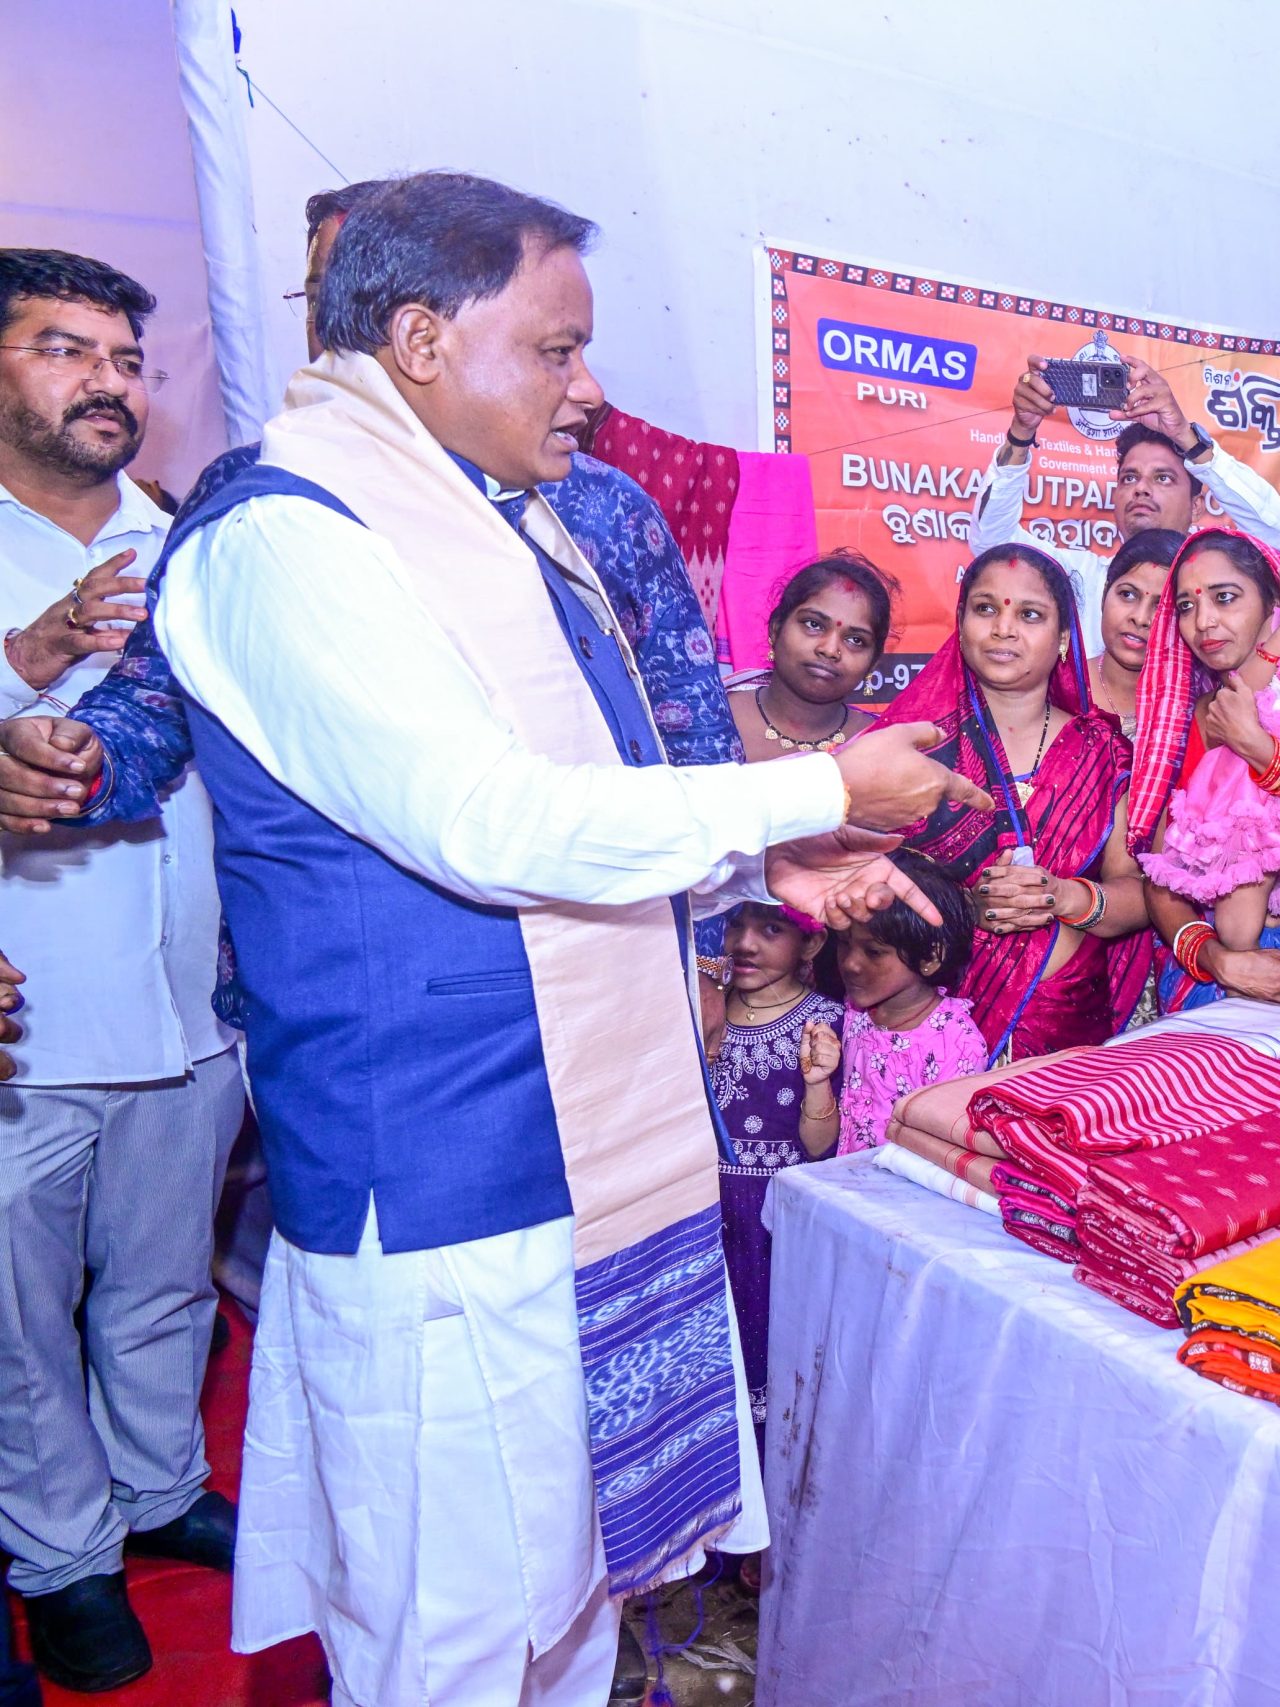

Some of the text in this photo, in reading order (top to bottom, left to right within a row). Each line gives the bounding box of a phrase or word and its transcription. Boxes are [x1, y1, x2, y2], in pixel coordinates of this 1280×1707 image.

[823, 329, 967, 381] ORMAS
[857, 382, 927, 409] PURI
[970, 429, 1005, 444] Handl
[1084, 446, 1093, 456] &
[1096, 446, 1120, 458] Han
[841, 453, 1116, 510] BUNAKA UTPAD
[1039, 457, 1118, 475] Government o
[882, 504, 972, 543] ବୁଣାକ
